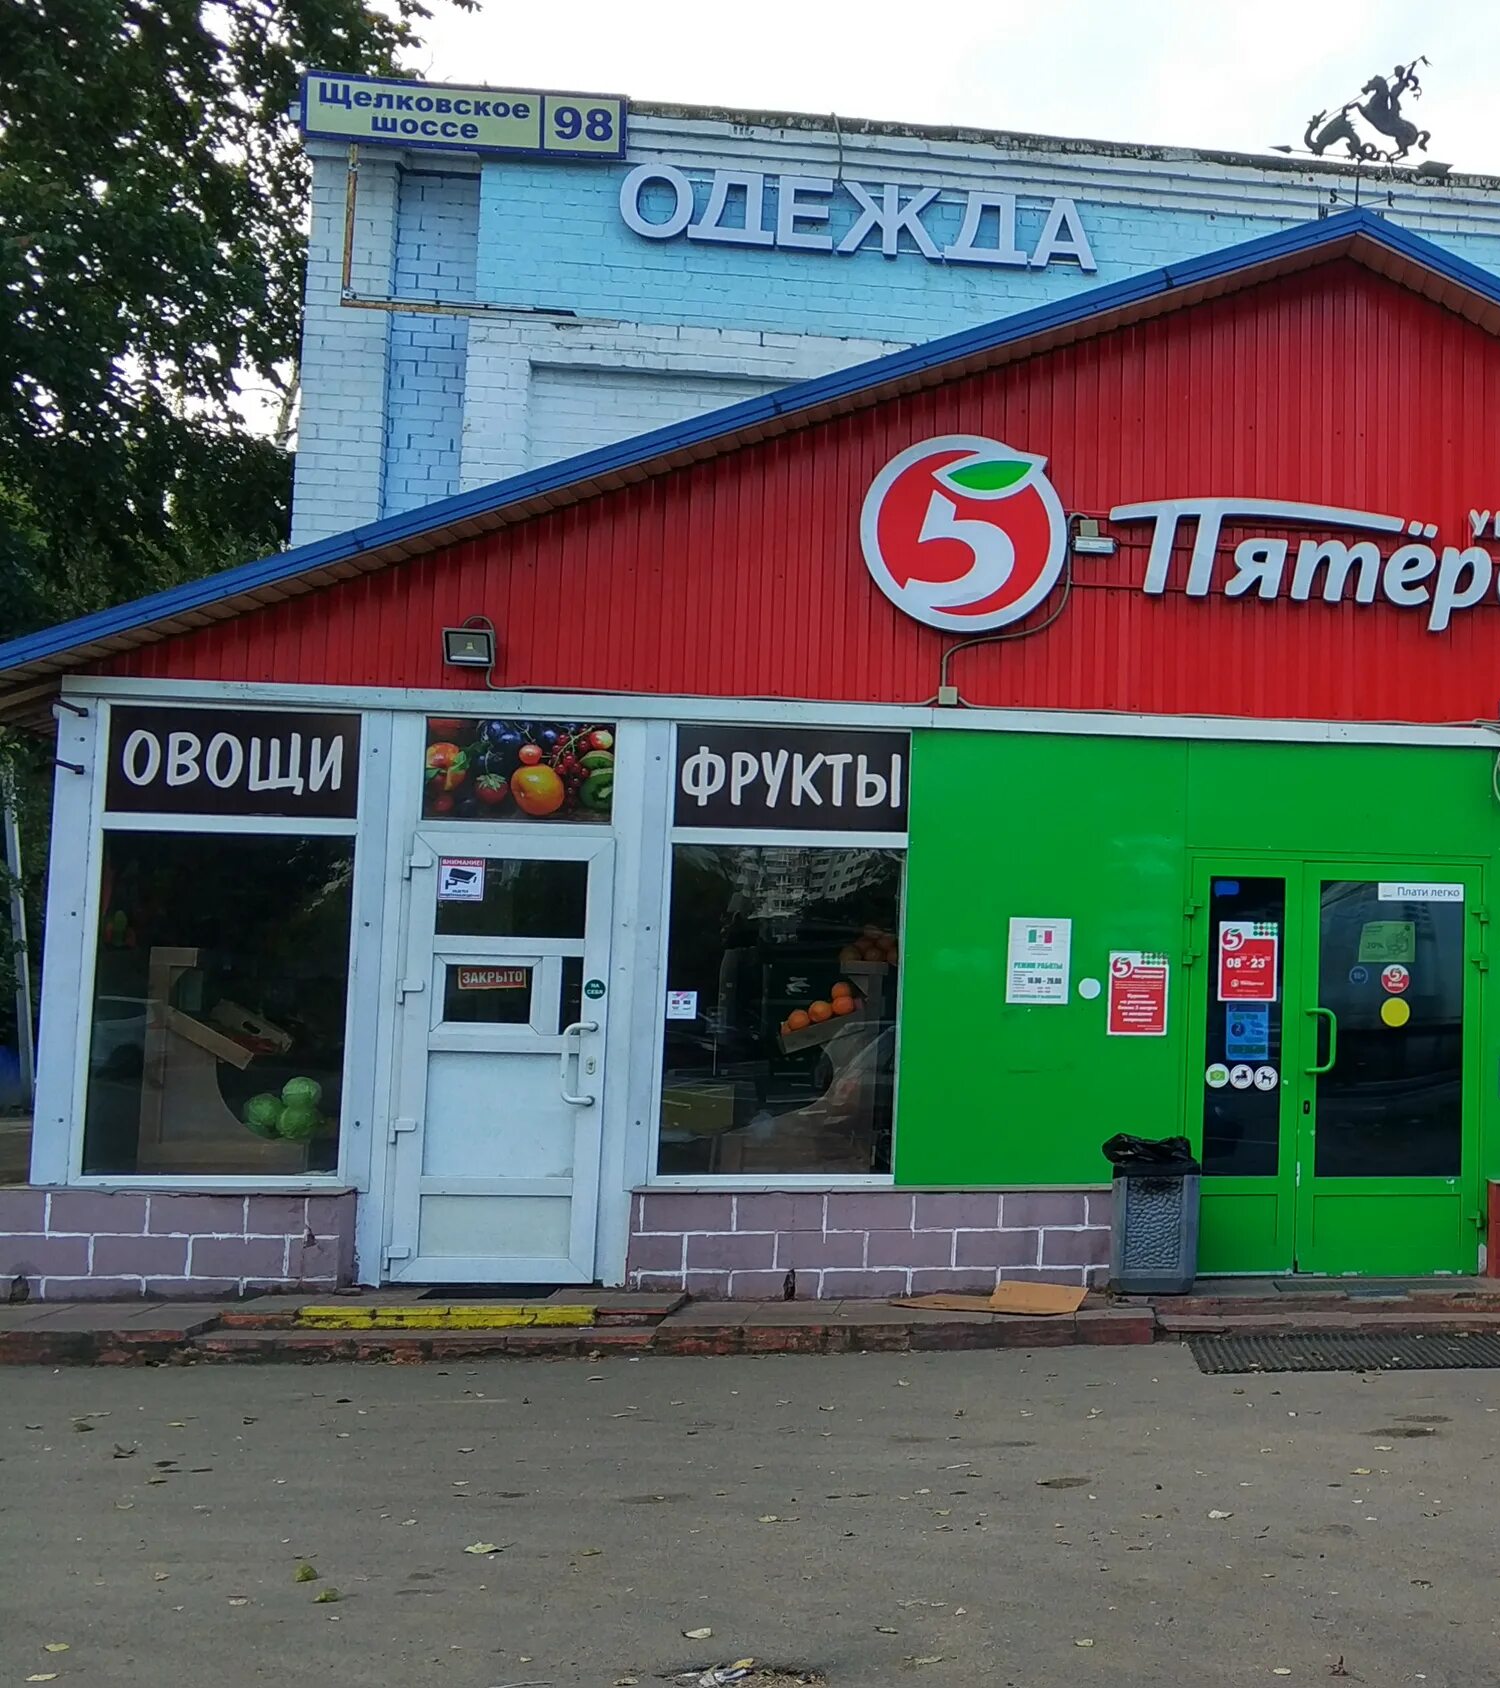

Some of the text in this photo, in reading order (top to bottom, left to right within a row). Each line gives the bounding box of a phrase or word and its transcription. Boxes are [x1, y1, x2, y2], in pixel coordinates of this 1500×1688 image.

[317, 80, 532, 120] Щелковское
[369, 114, 480, 141] шоссе
[554, 106, 613, 142] 98
[619, 163, 1097, 272] ОДЕЖДА
[122, 729, 344, 797] ОВОЩИ
[680, 744, 903, 809] ФРУКТЫ
[1397, 886, 1460, 898] Плати легко
[461, 970, 524, 985] ЗАКРЫТО
